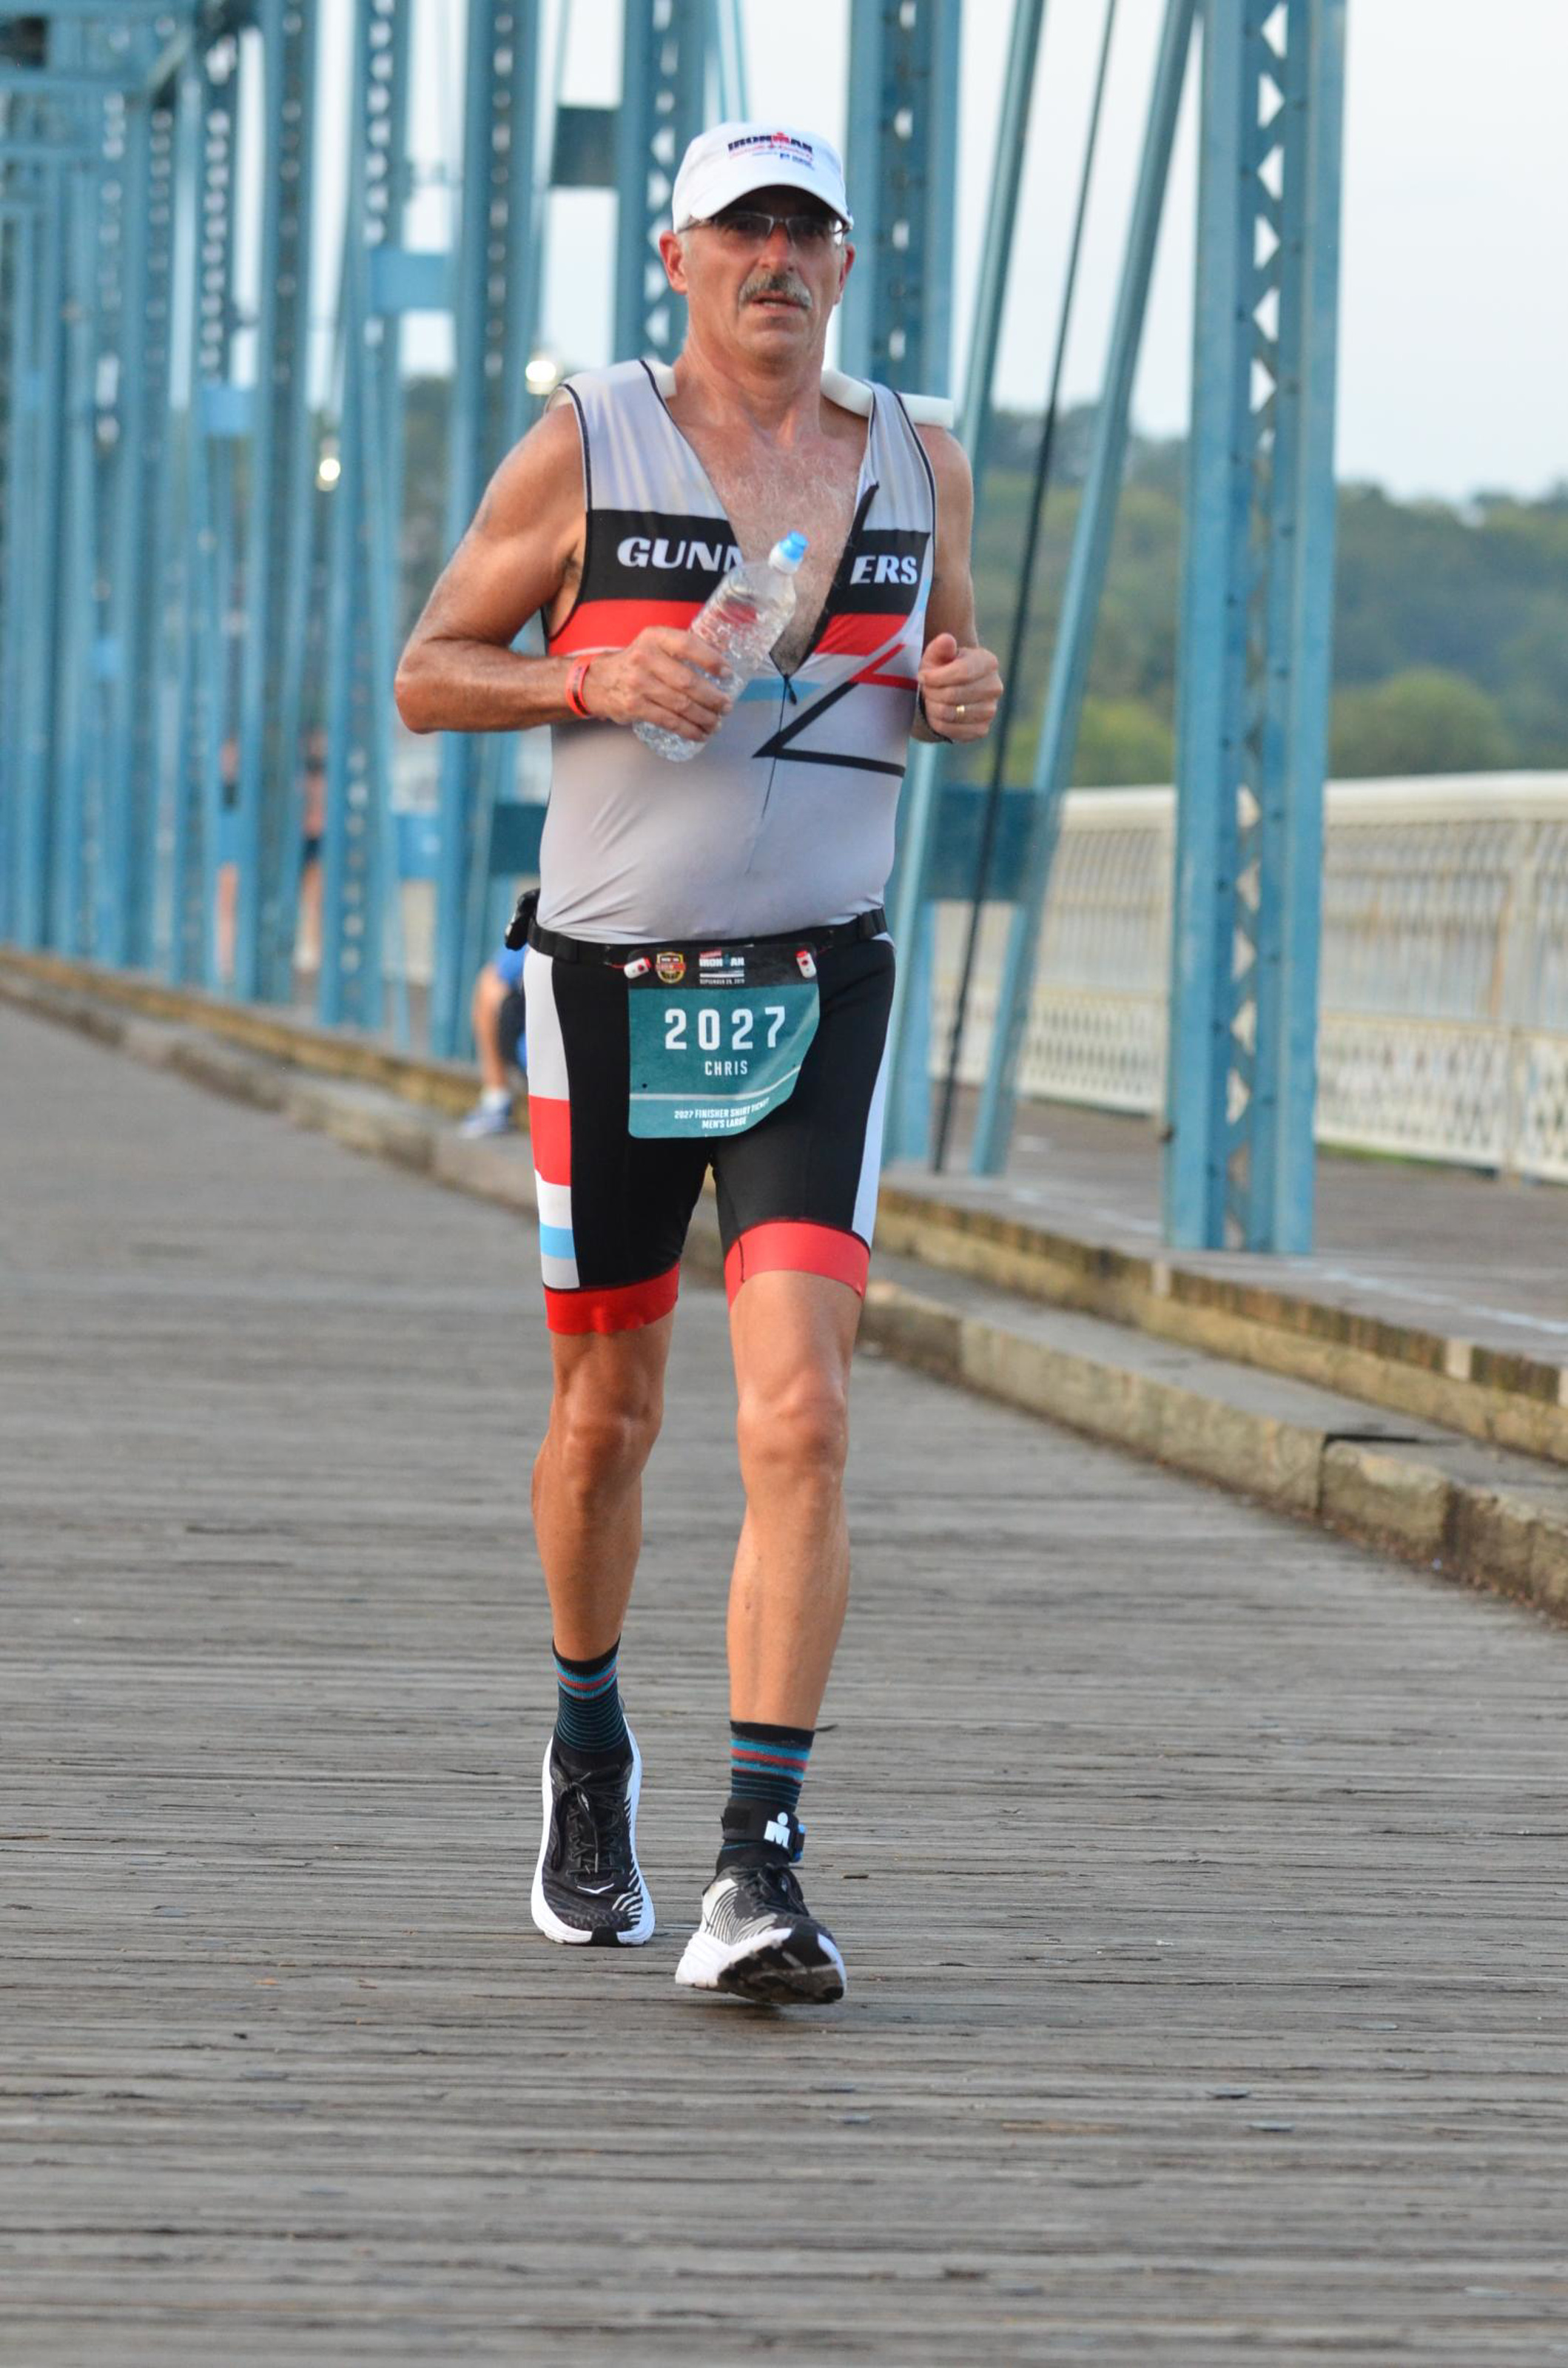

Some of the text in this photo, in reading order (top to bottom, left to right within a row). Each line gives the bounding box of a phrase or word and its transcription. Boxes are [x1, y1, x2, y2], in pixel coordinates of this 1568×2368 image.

[727, 131, 812, 152] IRONMAN
[850, 554, 918, 585] ERS
[664, 1006, 786, 1050] 2027
[704, 1060, 748, 1075] CHRIS
[674, 1110, 694, 1120] 2027
[694, 1109, 730, 1119] FINISHER
[730, 1105, 751, 1117] SHIRT
[701, 1116, 747, 1128] MEN'S LARGE
